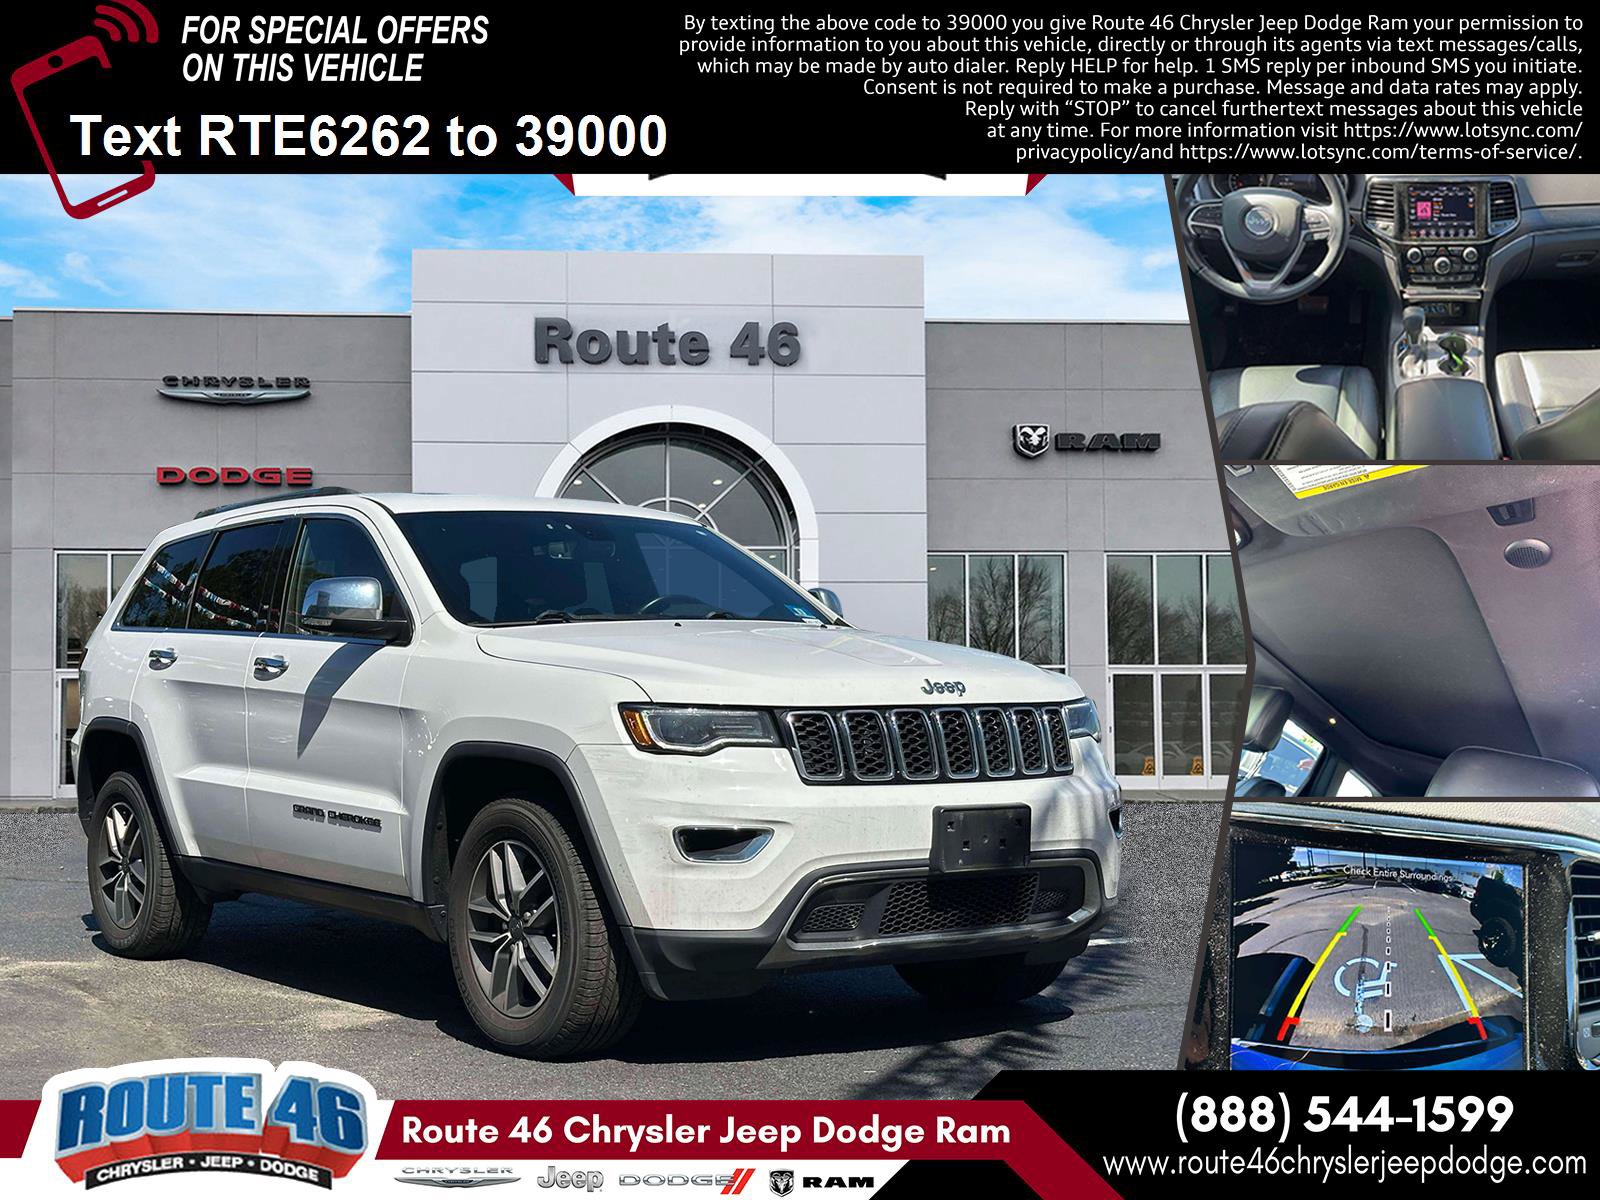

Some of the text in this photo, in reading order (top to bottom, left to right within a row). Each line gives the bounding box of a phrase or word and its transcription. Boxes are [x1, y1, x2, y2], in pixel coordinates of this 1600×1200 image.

[534, 317, 801, 367] Route 46
[162, 375, 311, 388] CHRYSLER
[1055, 433, 1161, 452] RAM
[156, 466, 313, 486] DODGE
[921, 678, 966, 697] Jeep
[293, 804, 325, 818] GRAND
[1343, 866, 1454, 883] Check Entire Surroundings
